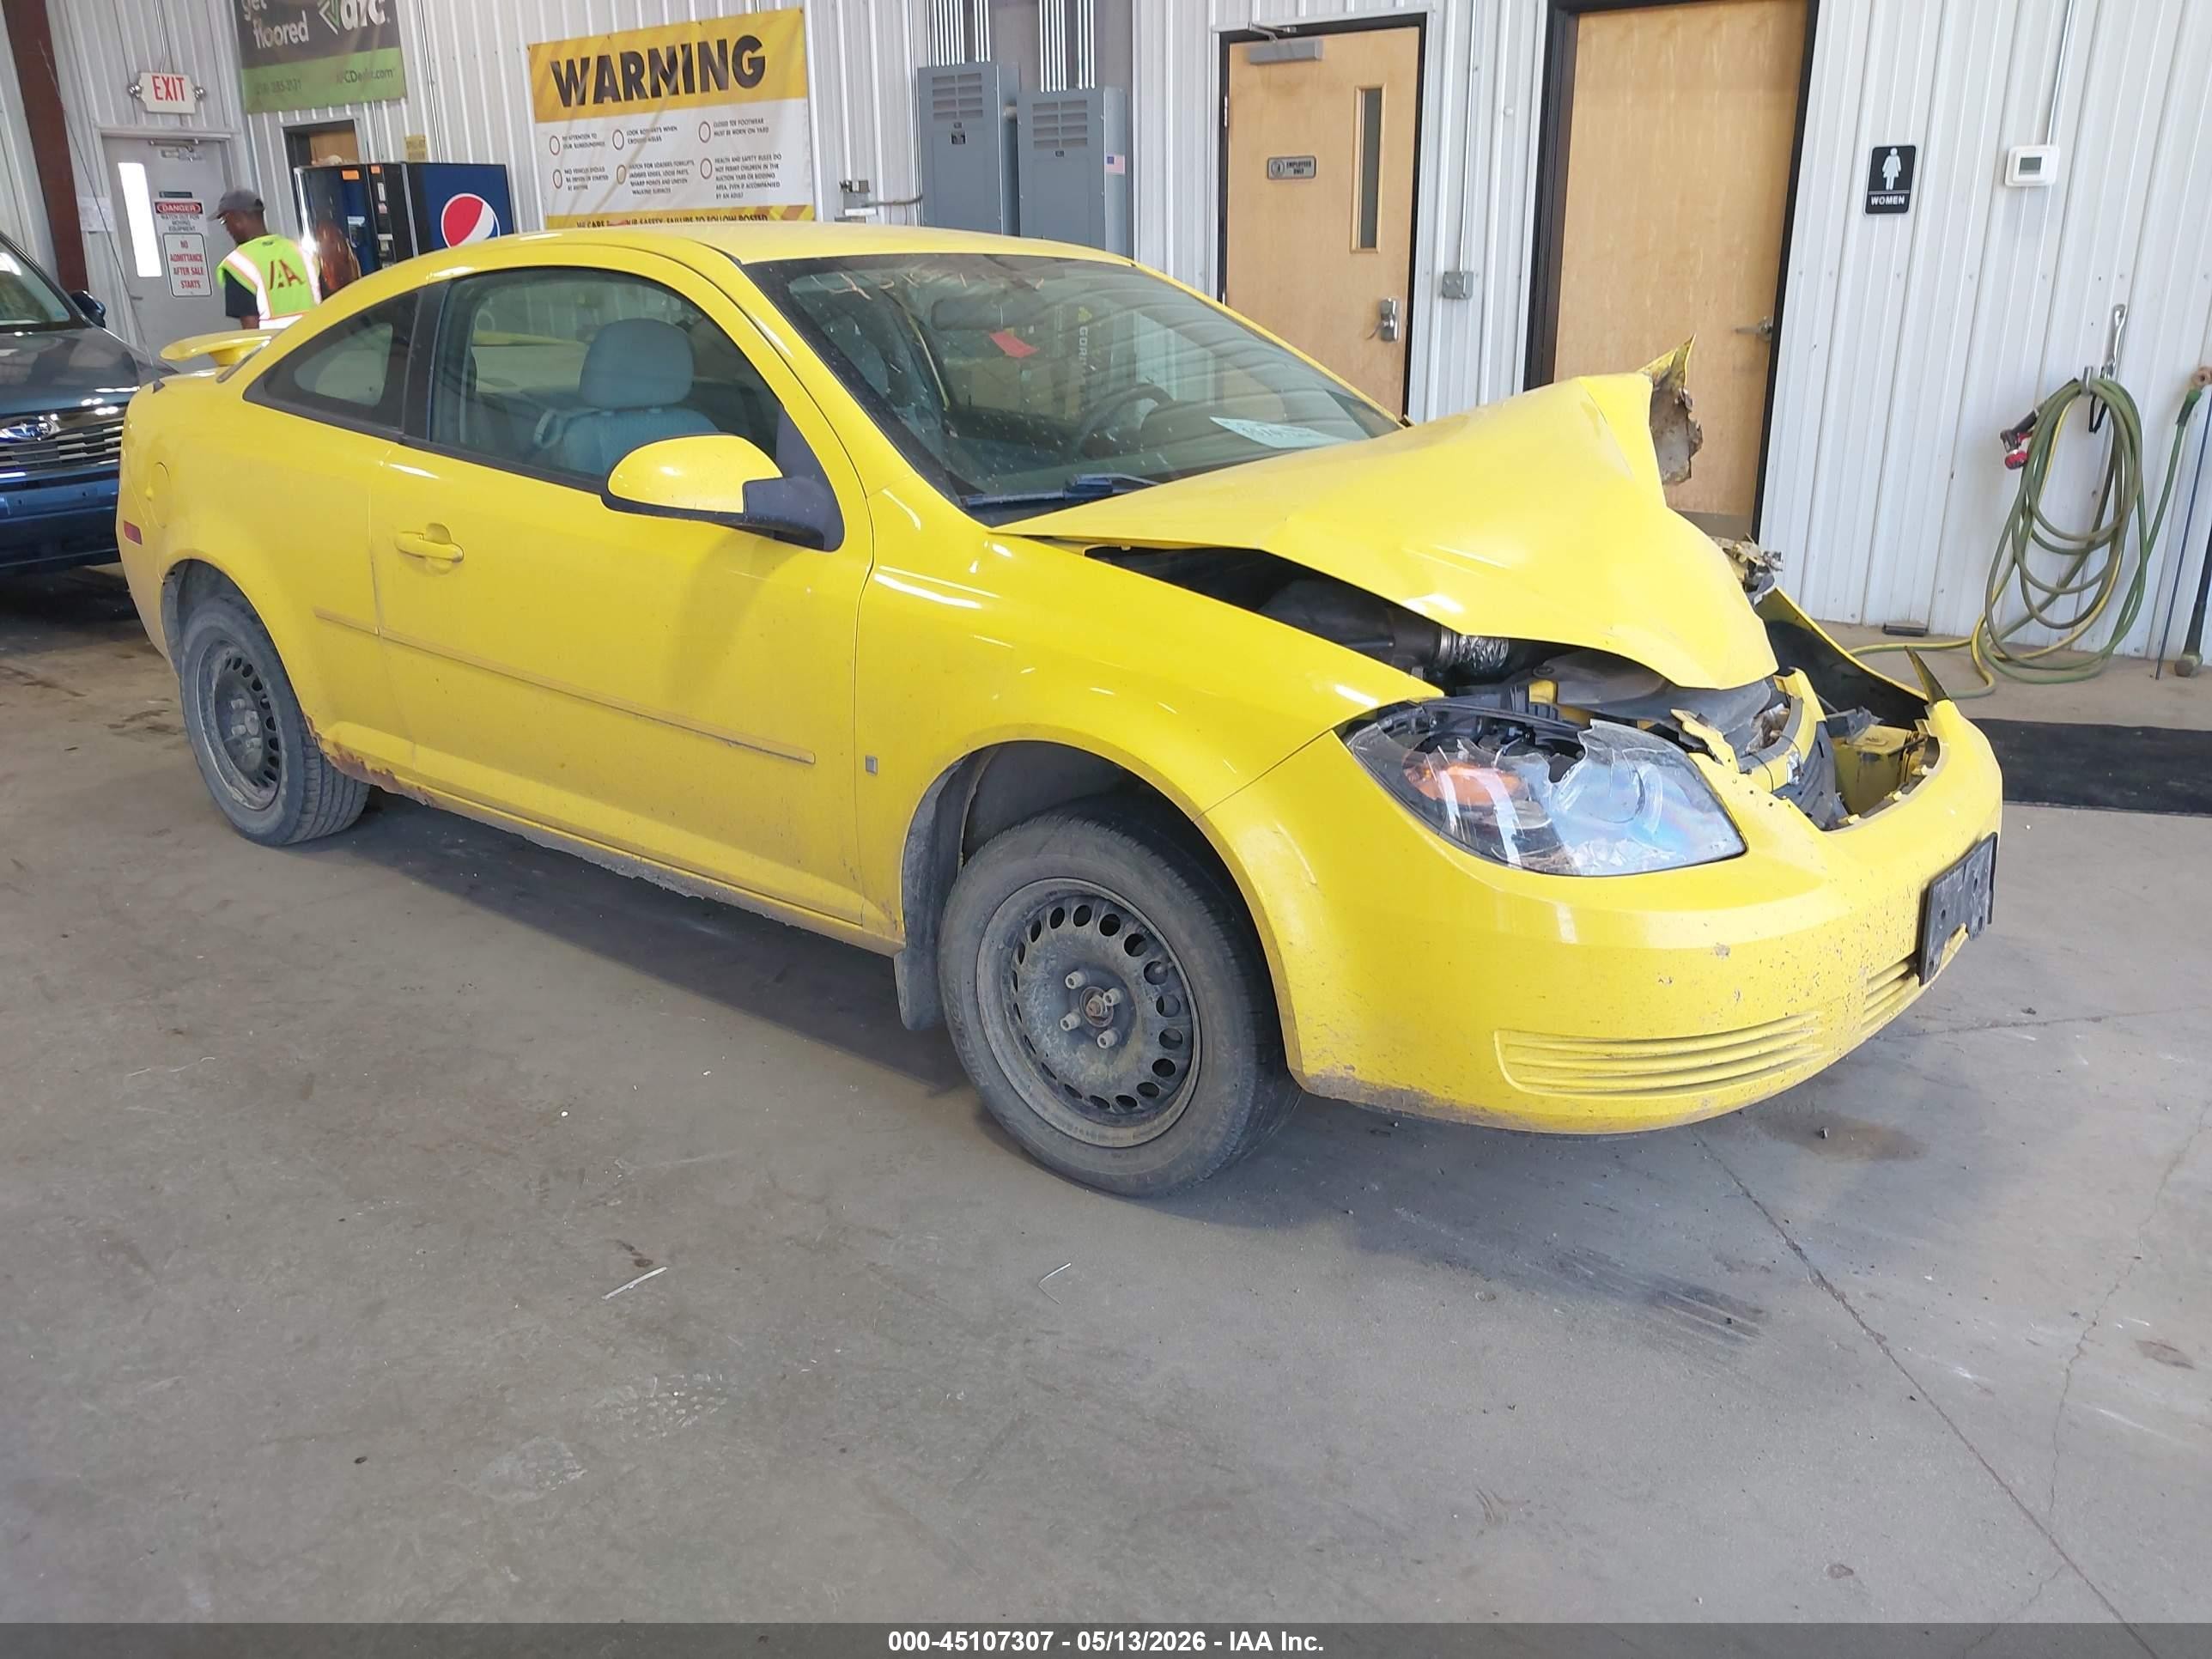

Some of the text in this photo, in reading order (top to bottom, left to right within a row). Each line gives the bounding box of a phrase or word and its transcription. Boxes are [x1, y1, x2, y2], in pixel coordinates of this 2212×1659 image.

[252, 9, 309, 48] floored
[550, 34, 766, 107] WARNING
[152, 76, 185, 101] EXIT
[1871, 195, 1905, 205] WOMEN
[162, 203, 196, 212] DANGER
[170, 253, 204, 262] ADMITTANCE
[191, 267, 204, 276] SALE
[180, 280, 201, 289] STARTS
